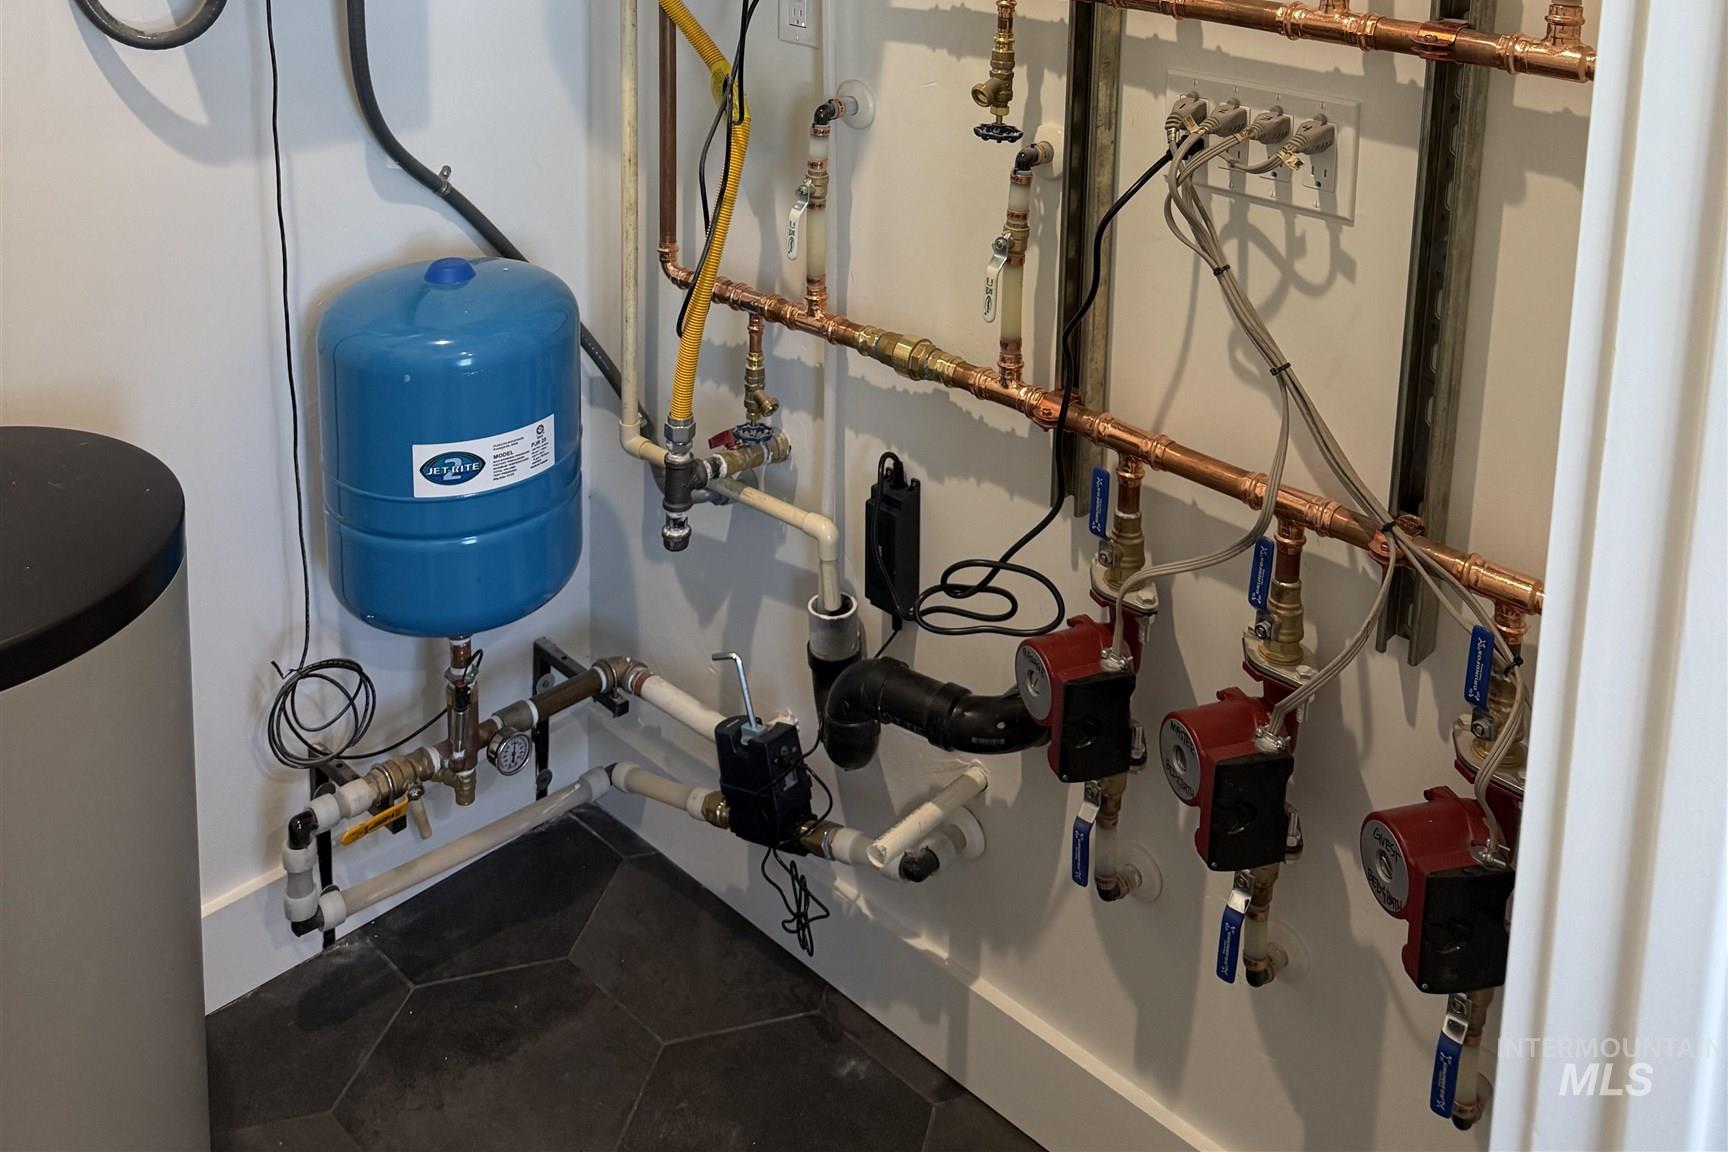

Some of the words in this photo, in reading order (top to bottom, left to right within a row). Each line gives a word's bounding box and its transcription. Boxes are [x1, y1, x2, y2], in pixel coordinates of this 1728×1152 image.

[493, 450, 514, 460] MODEL
[425, 466, 449, 476] JET
[451, 462, 480, 473] RITE
[1473, 643, 1483, 691] GRUNDFOS
